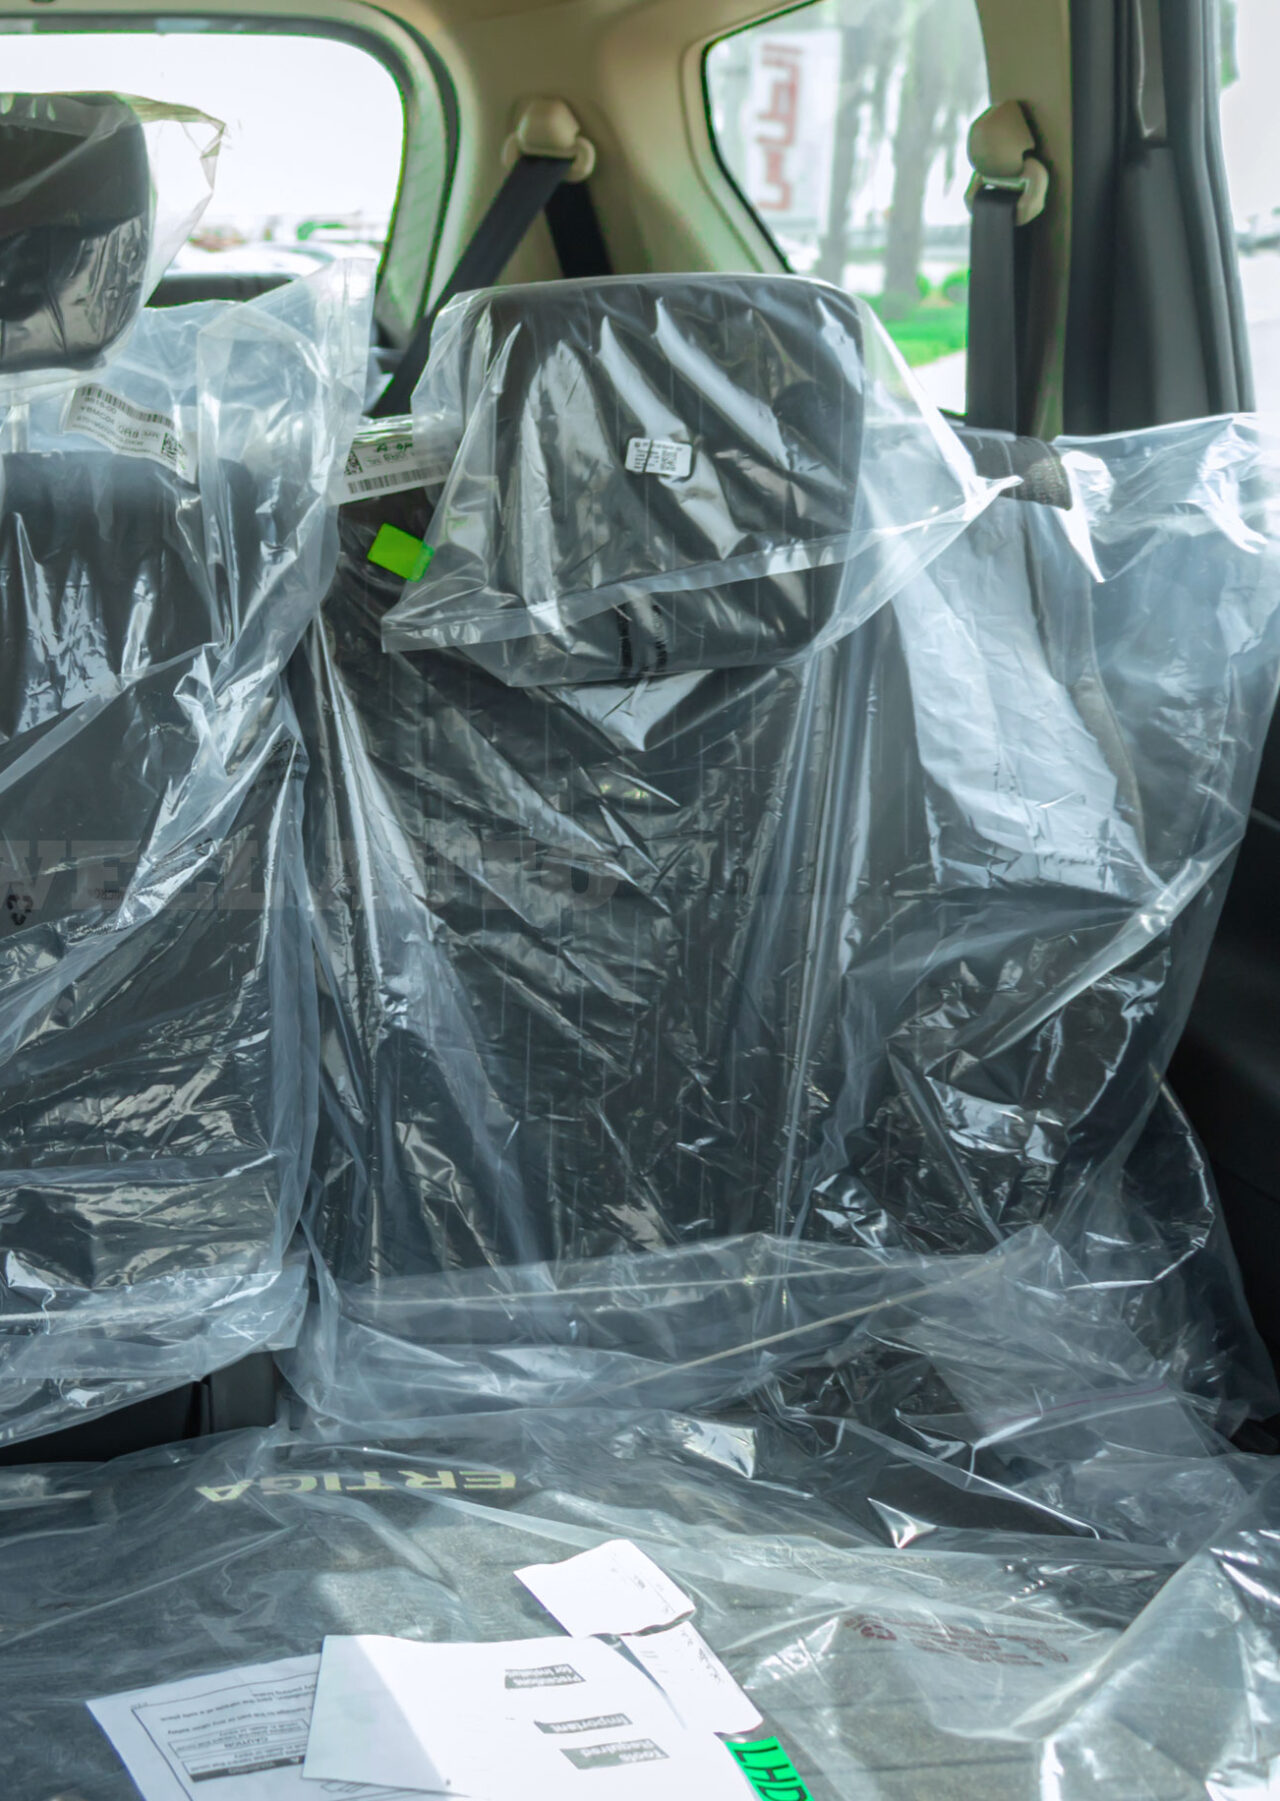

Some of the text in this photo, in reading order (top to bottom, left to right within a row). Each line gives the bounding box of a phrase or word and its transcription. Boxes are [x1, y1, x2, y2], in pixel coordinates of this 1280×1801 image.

[195, 1470, 516, 1502] ERTIGA
[549, 1714, 629, 1732] Important
[580, 1739, 656, 1758] Required
[619, 1750, 664, 1763] Tools
[733, 1745, 807, 1801] LHD
